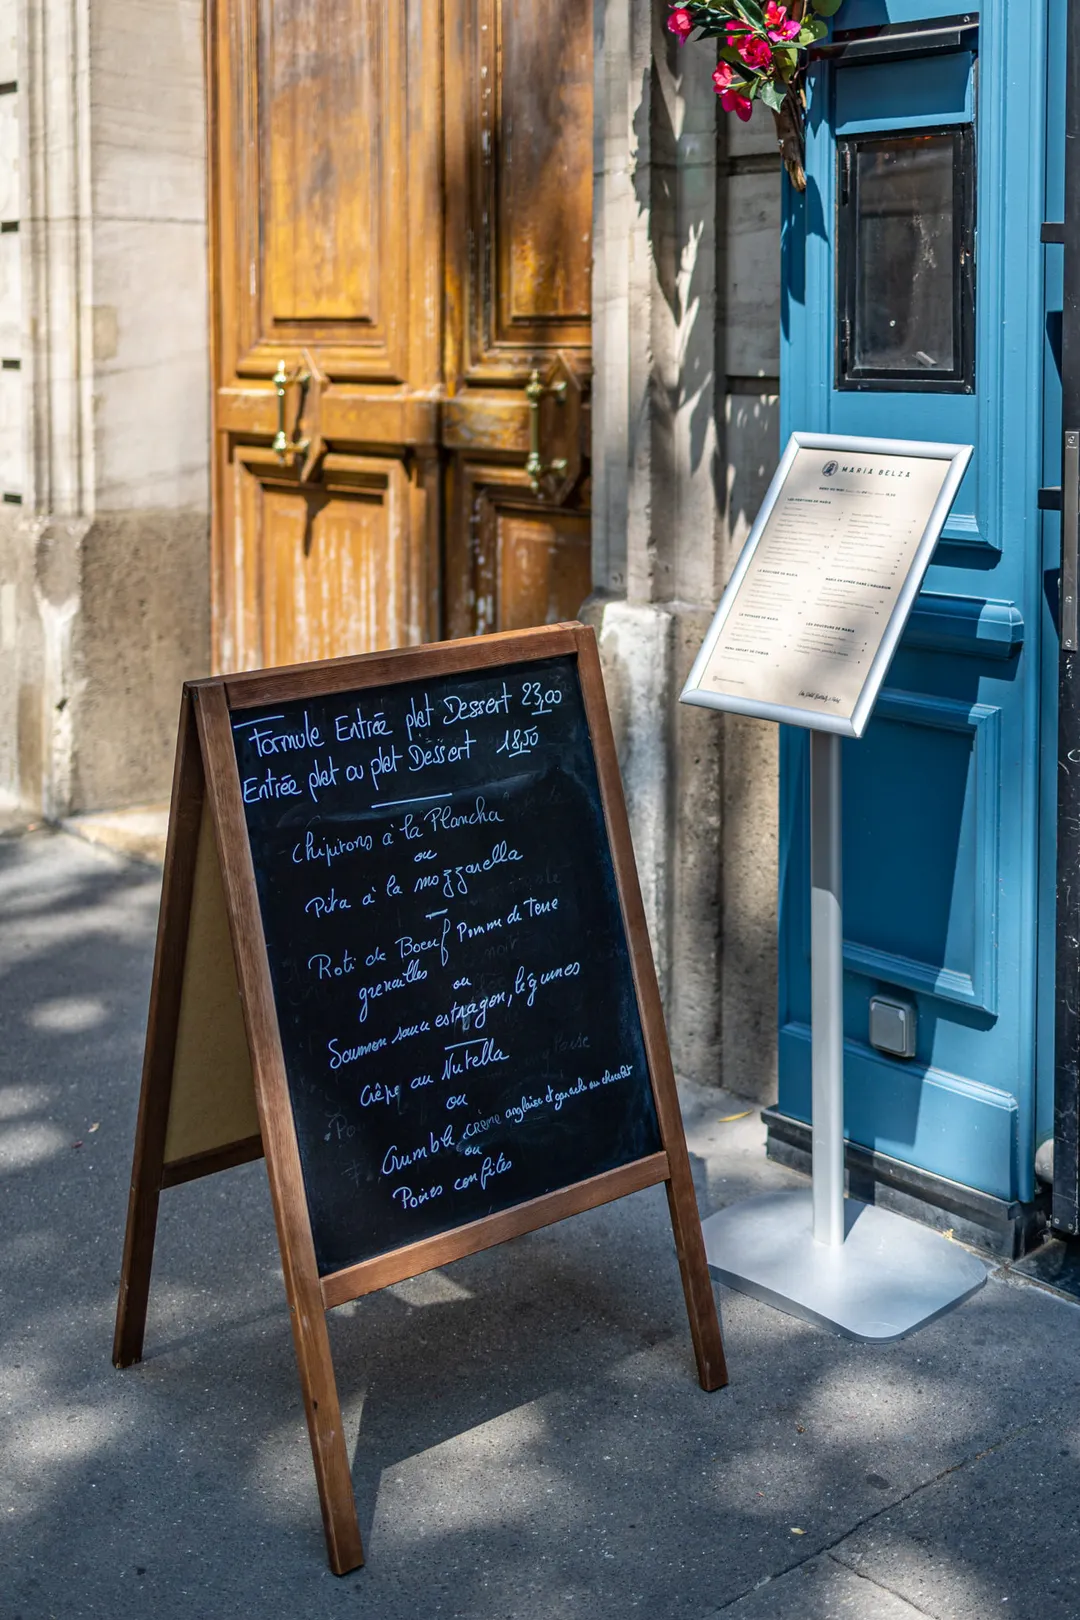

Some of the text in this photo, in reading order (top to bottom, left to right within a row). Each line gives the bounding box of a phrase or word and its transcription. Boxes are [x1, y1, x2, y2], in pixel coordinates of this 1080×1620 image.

[878, 469, 911, 478] BELZA
[233, 711, 325, 757] Formule
[405, 692, 435, 741] plat
[442, 682, 513, 726] Dessert
[308, 755, 340, 803] plat
[346, 765, 364, 781] ou
[370, 744, 404, 791] plat
[408, 729, 477, 772] Dessert
[382, 823, 395, 846] à
[399, 813, 424, 840] la
[423, 795, 505, 832] Plancha
[305, 840, 524, 919] Pita à la mozzarella
[413, 849, 438, 862] ou
[365, 946, 387, 966] de
[456, 917, 504, 943] Pomme
[506, 904, 524, 925] de
[523, 897, 560, 917] Terre
[453, 976, 473, 990] ou
[328, 1038, 388, 1069] Saumon
[391, 1020, 431, 1044] sauce
[514, 961, 581, 1007] légumes
[360, 1082, 401, 1107] Crêpe
[410, 1074, 435, 1089] au
[441, 1037, 509, 1081] Nutella
[445, 1093, 469, 1110] ou
[382, 1124, 456, 1175] Crumble
[505, 1095, 544, 1123] anglaise
[545, 1084, 554, 1103] et
[588, 1080, 601, 1090] au
[601, 1064, 634, 1085] chocolat
[464, 1145, 483, 1156] ou
[392, 1151, 512, 1209] Poires confites
